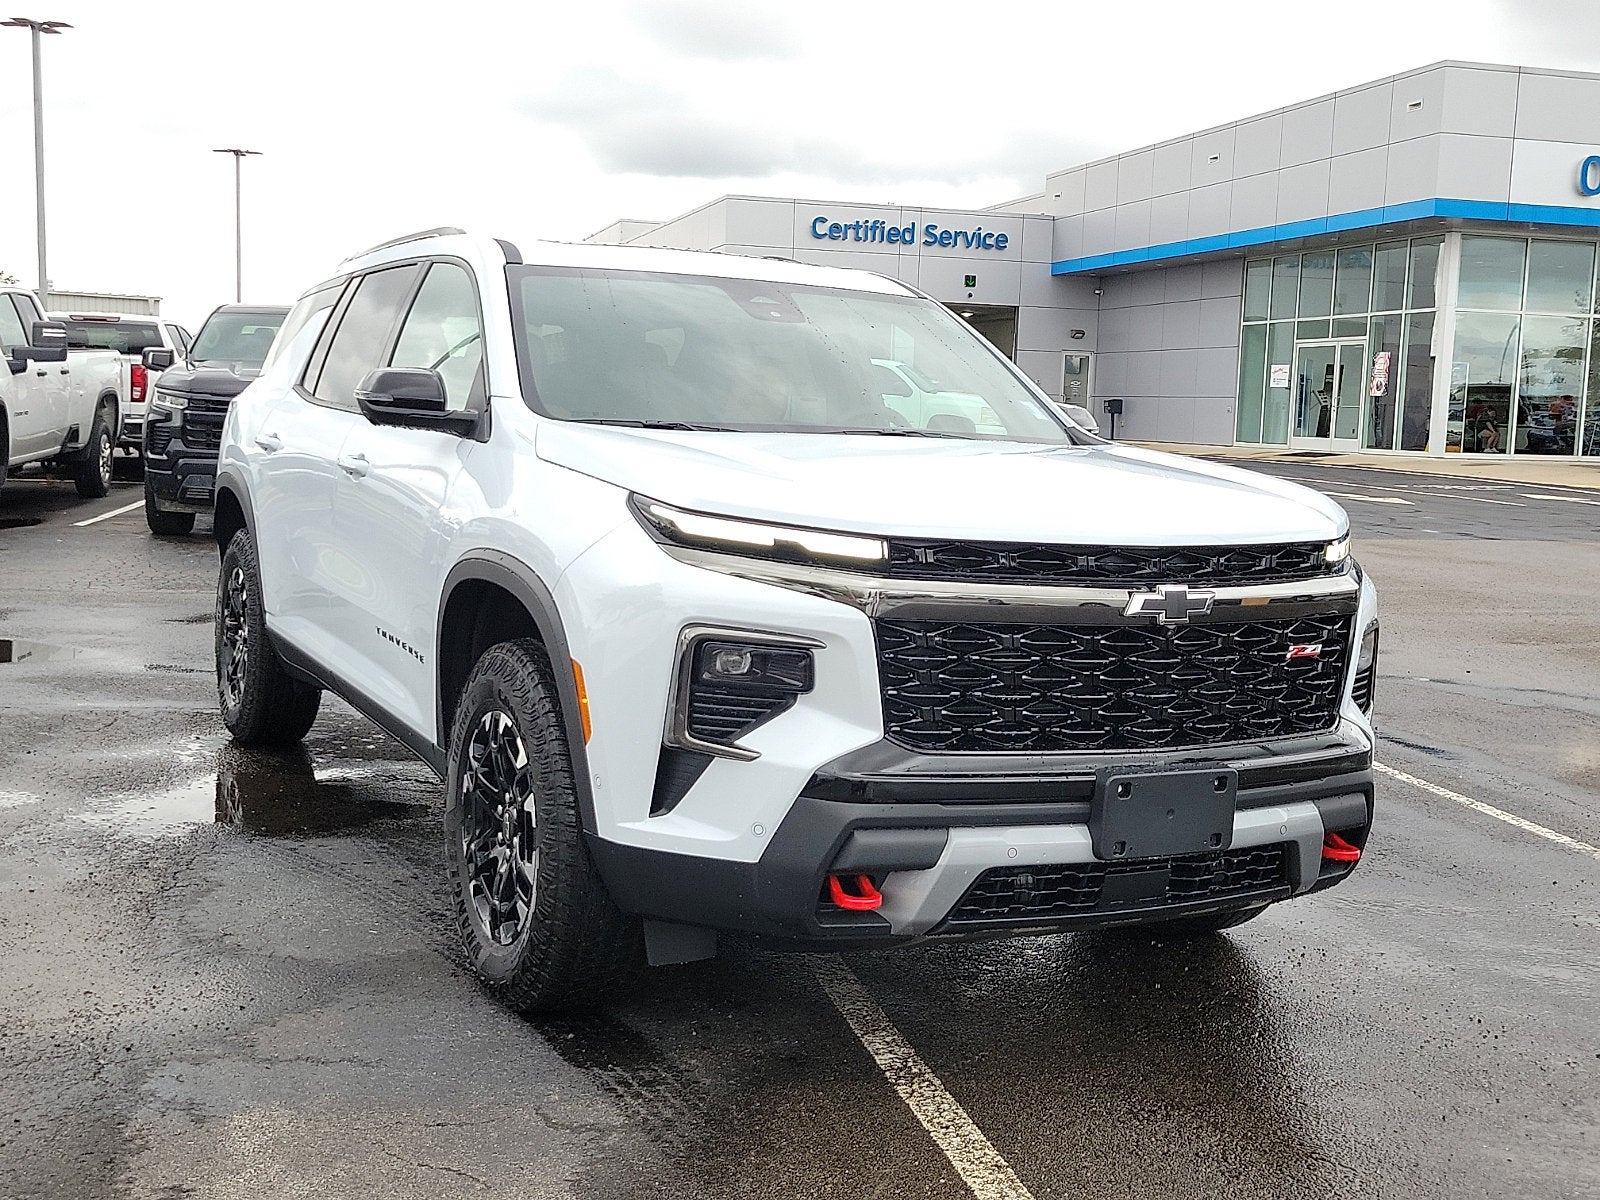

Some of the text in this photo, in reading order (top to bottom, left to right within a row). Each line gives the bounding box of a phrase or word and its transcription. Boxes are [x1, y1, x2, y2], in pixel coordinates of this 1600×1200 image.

[811, 216, 1009, 250] Certified Service
[375, 626, 425, 664] TRAVERSE
